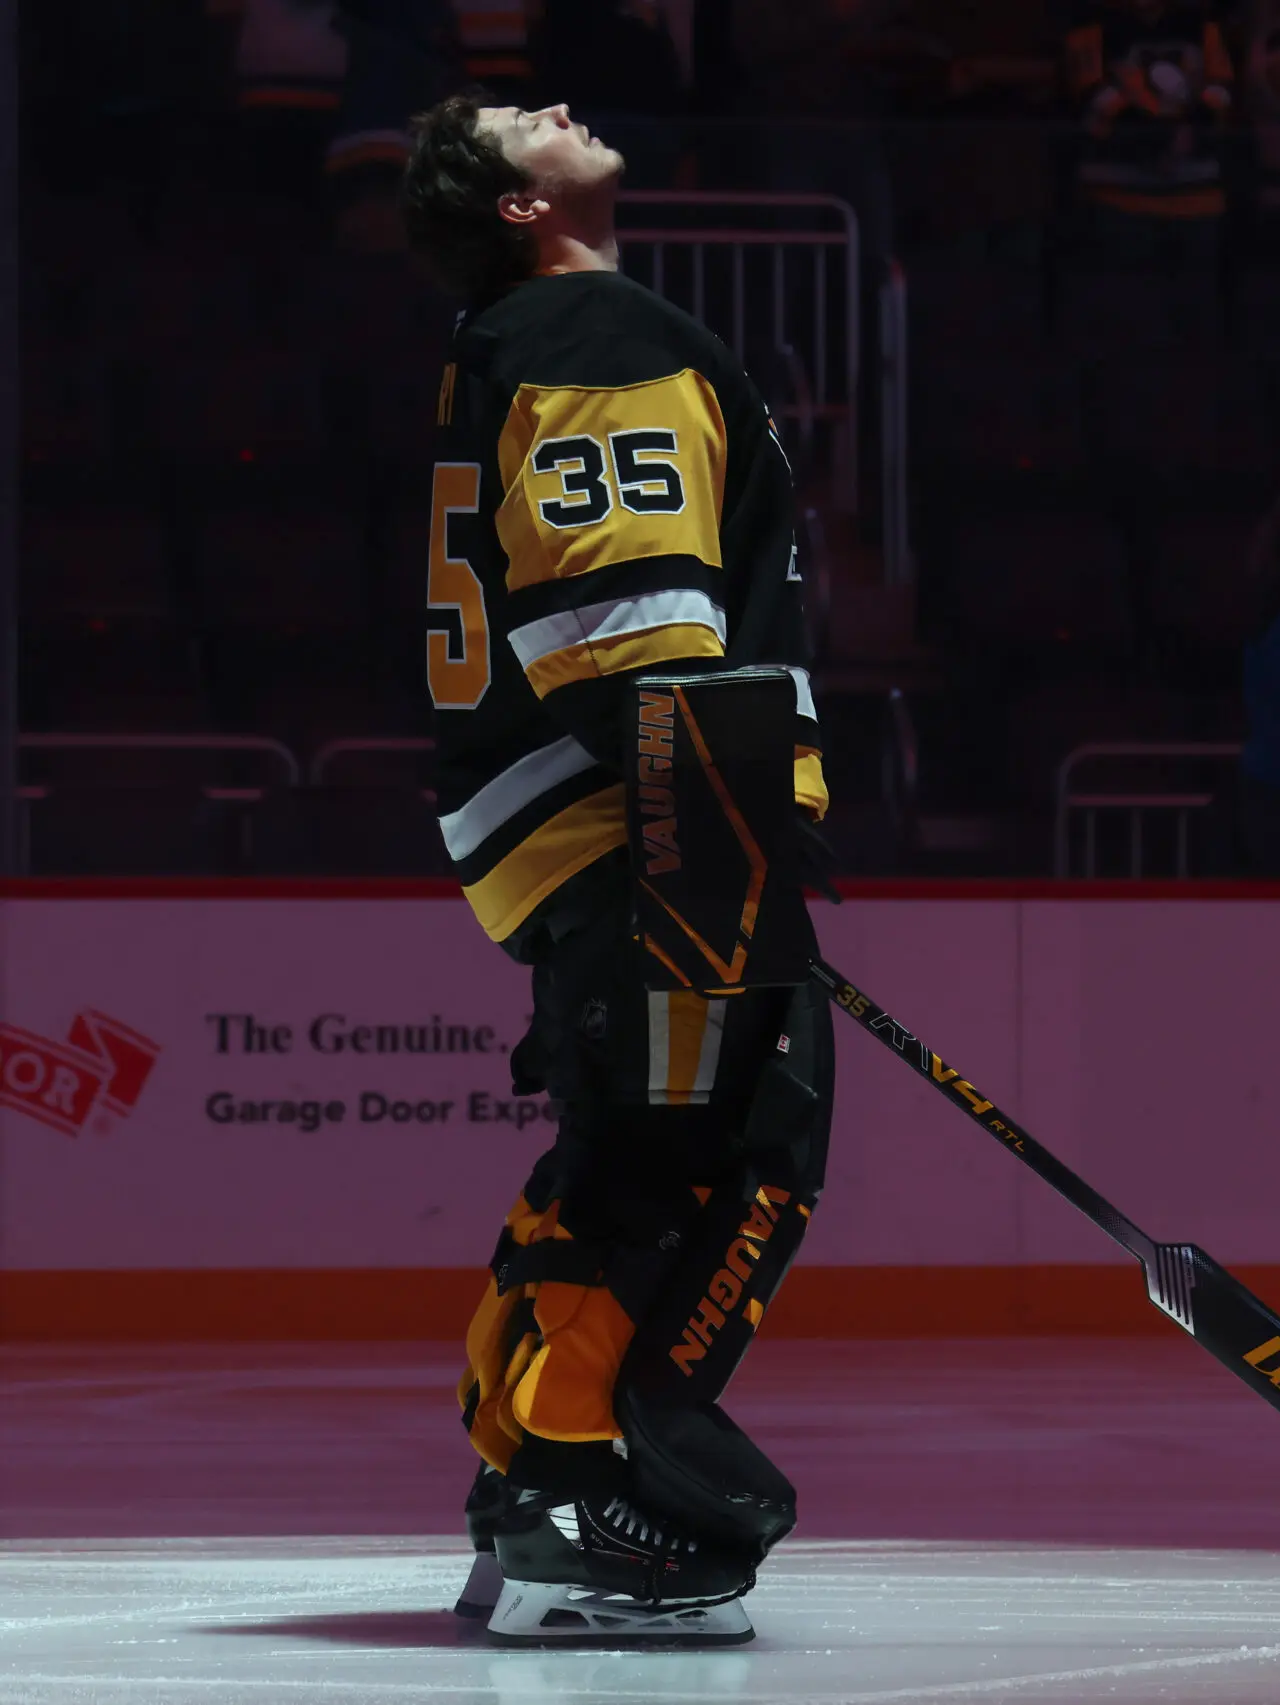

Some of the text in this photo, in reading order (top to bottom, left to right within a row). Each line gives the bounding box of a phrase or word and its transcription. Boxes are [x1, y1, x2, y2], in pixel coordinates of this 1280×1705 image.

[531, 427, 687, 530] 35
[638, 691, 682, 876] VAUGHN
[205, 1013, 508, 1054] The Genuine.
[836, 984, 871, 1017] 35
[989, 1119, 1025, 1153] RTL
[205, 1091, 347, 1132] Garage
[359, 1091, 455, 1123] Door
[668, 1184, 792, 1378] VAUGHN
